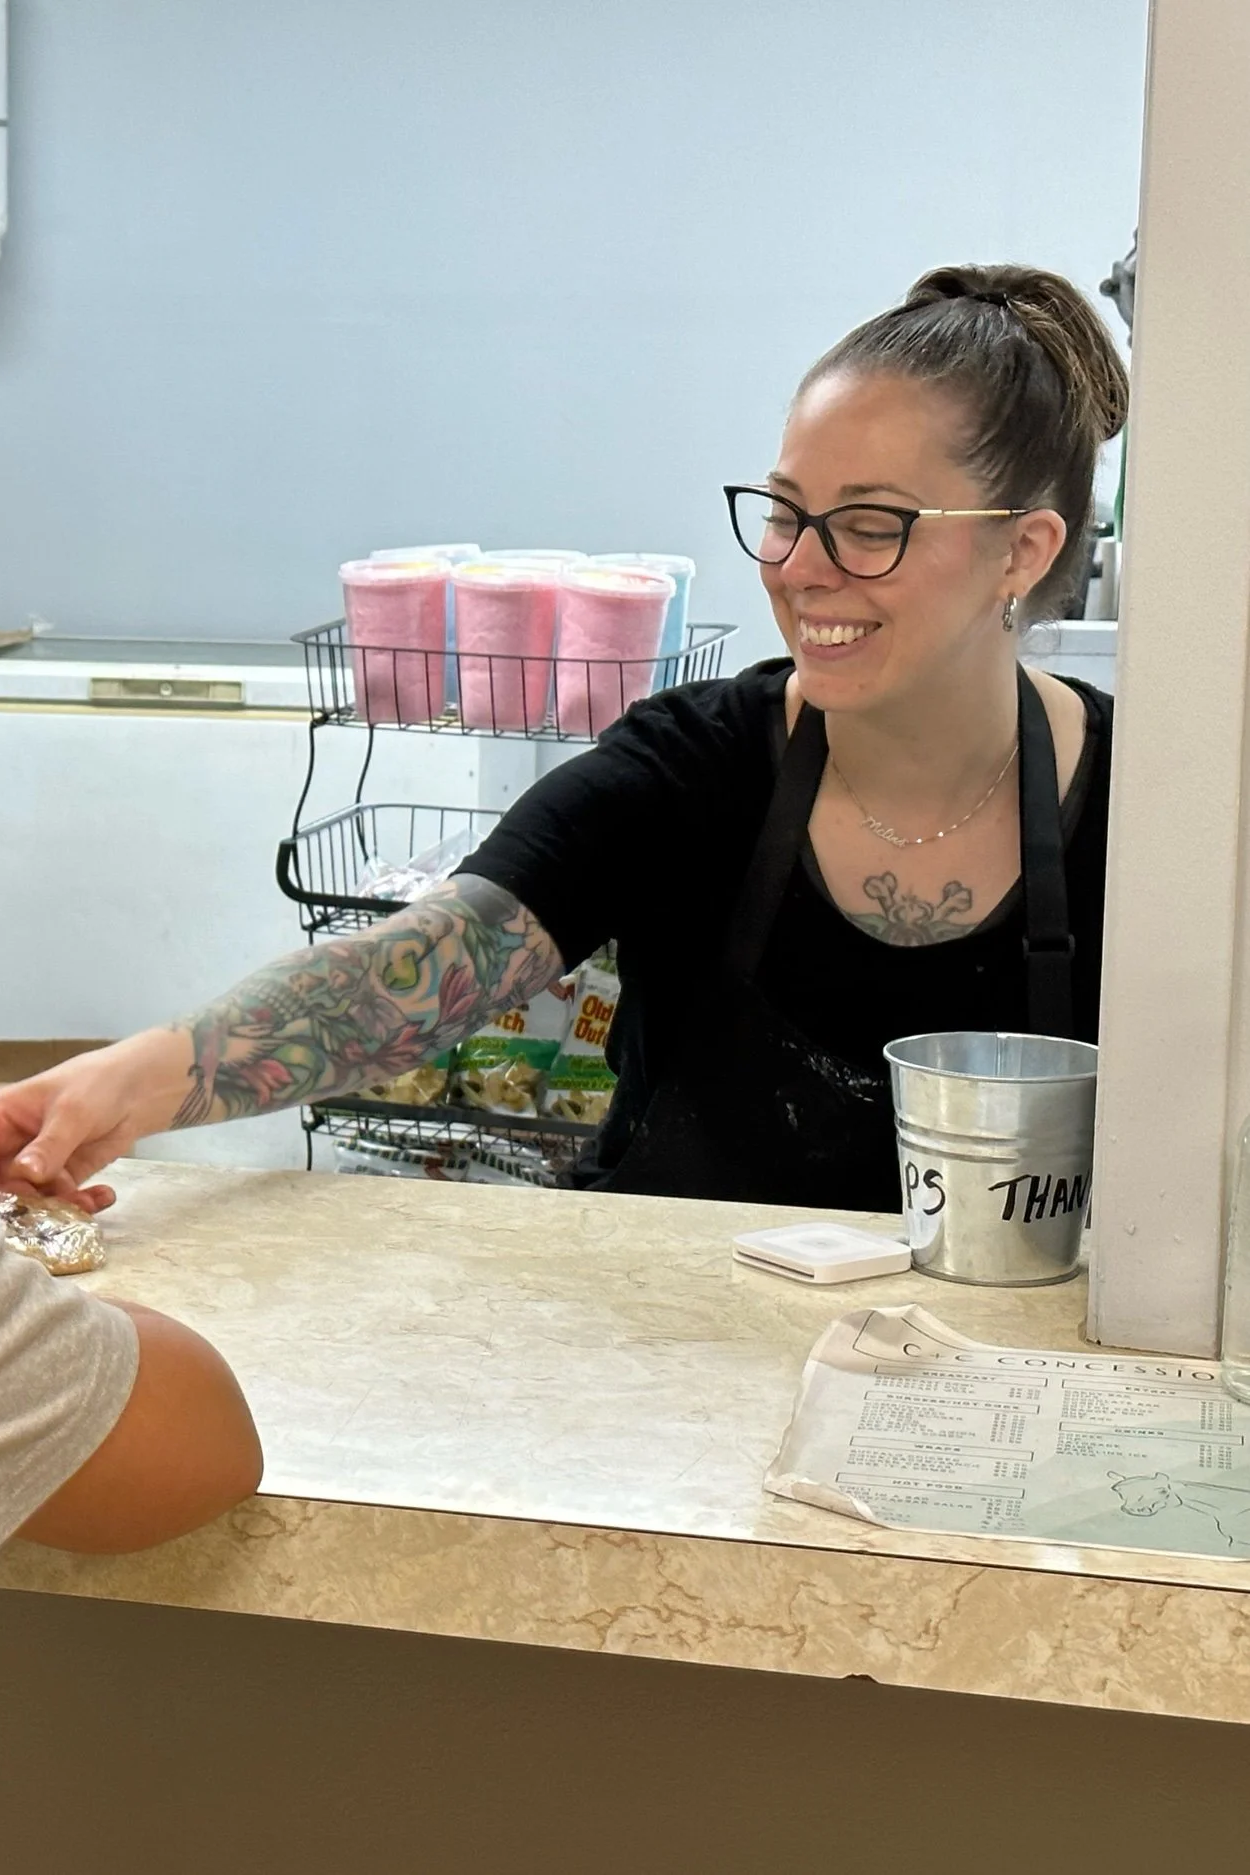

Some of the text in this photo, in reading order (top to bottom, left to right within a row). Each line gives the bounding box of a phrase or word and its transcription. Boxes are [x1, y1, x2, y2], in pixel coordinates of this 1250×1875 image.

[582, 994, 614, 1022] Old
[905, 1160, 1092, 1223] PS THAN
[903, 1343, 922, 1358] C
[954, 1354, 975, 1362] C
